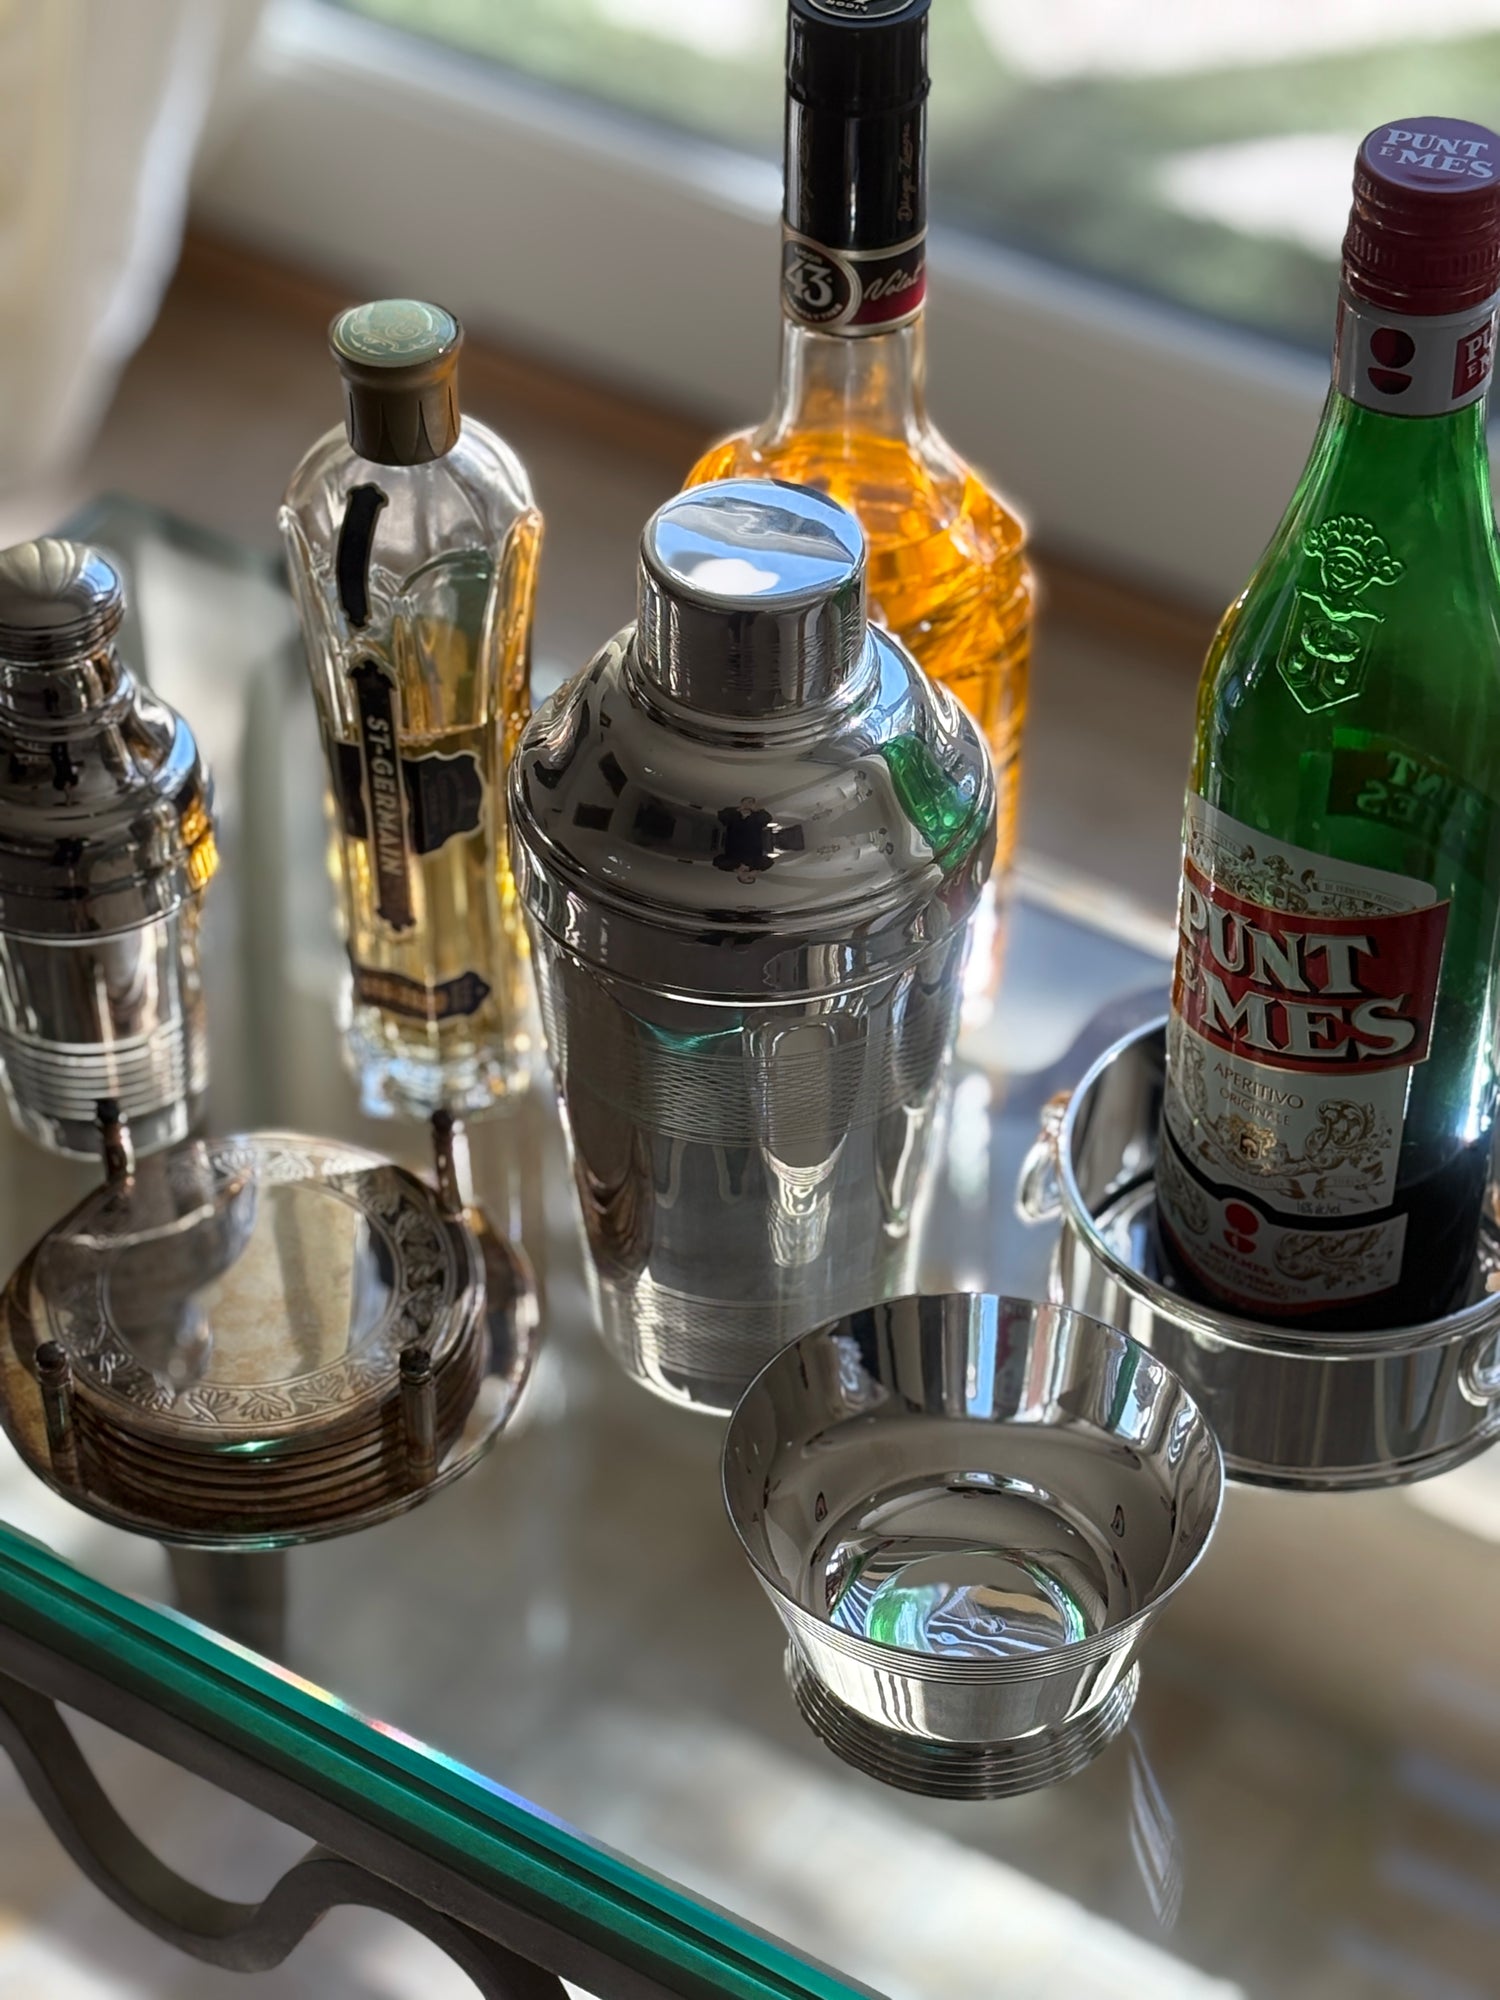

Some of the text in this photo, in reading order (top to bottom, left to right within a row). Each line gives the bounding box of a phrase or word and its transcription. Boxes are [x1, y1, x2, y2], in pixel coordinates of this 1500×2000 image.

[1379, 145, 1493, 178] E MES
[1383, 128, 1488, 158] PUNT
[785, 257, 833, 307] 43
[1465, 328, 1492, 363] PU
[367, 714, 403, 876] ST-GERMAIN
[1180, 877, 1374, 996] PUNT
[1180, 948, 1417, 1059] E MES
[1213, 1062, 1304, 1109] APERITIVO
[1219, 1088, 1290, 1126] ORIGINALE
